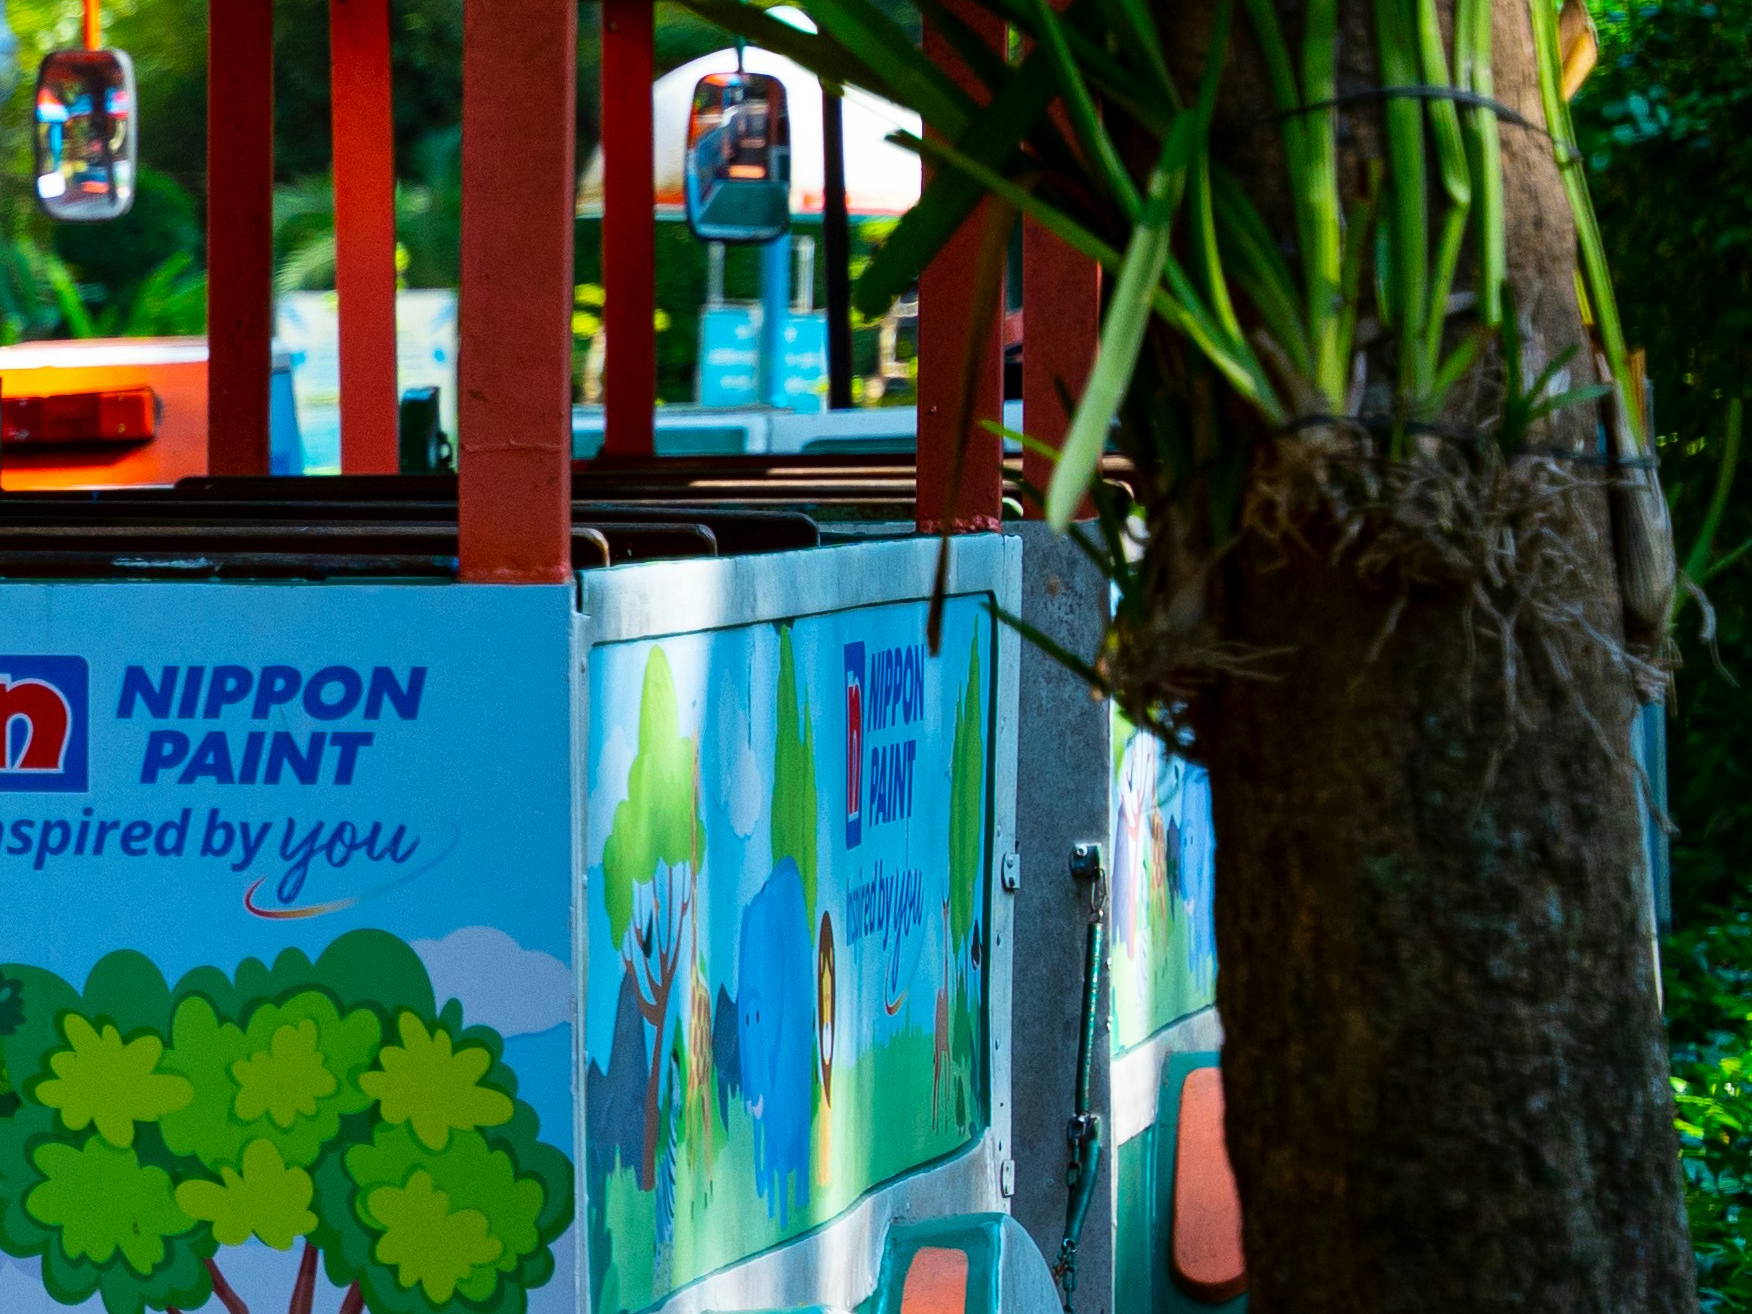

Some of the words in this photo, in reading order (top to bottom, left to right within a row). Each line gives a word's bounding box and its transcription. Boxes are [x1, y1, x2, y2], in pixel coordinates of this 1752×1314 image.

[116, 664, 428, 720] NIPPON
[867, 643, 925, 733] NIPPON
[139, 730, 376, 785] PAINT
[869, 739, 917, 828] PAINT
[200, 807, 273, 872] by
[279, 815, 422, 904] you
[877, 859, 894, 952] by
[892, 866, 924, 995] you
